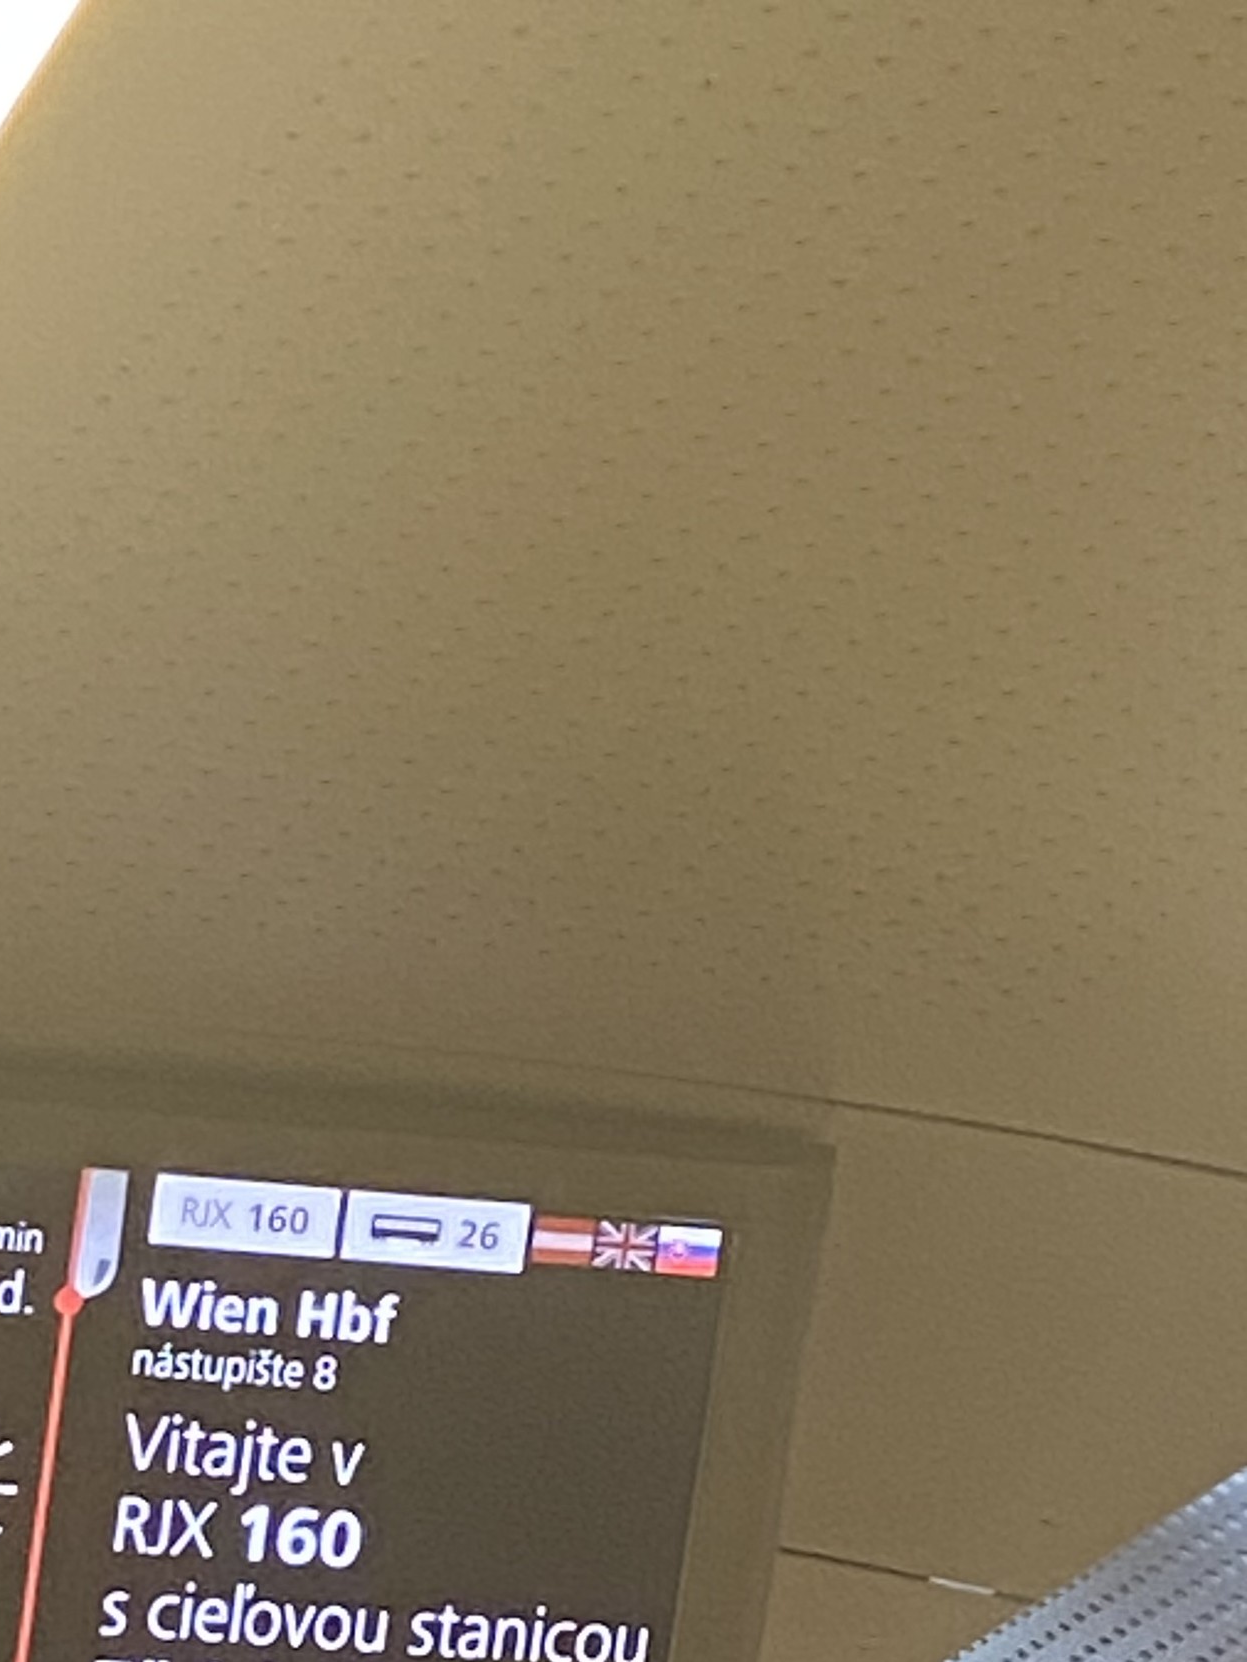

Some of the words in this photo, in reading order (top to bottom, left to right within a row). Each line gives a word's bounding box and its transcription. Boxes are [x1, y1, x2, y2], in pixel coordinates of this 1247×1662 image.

[181, 1196, 231, 1230] RJX
[248, 1203, 309, 1235] 160
[457, 1218, 500, 1250] 26
[142, 1278, 279, 1336] Wien
[296, 1289, 401, 1344] Hbf
[132, 1340, 305, 1392] nástupište
[313, 1354, 338, 1391] 8
[126, 1412, 313, 1496] Vitajte
[332, 1441, 366, 1486] v
[113, 1495, 218, 1559] RJX
[241, 1504, 363, 1569] 160
[99, 1590, 130, 1637] s
[147, 1580, 390, 1654] cieľovou
